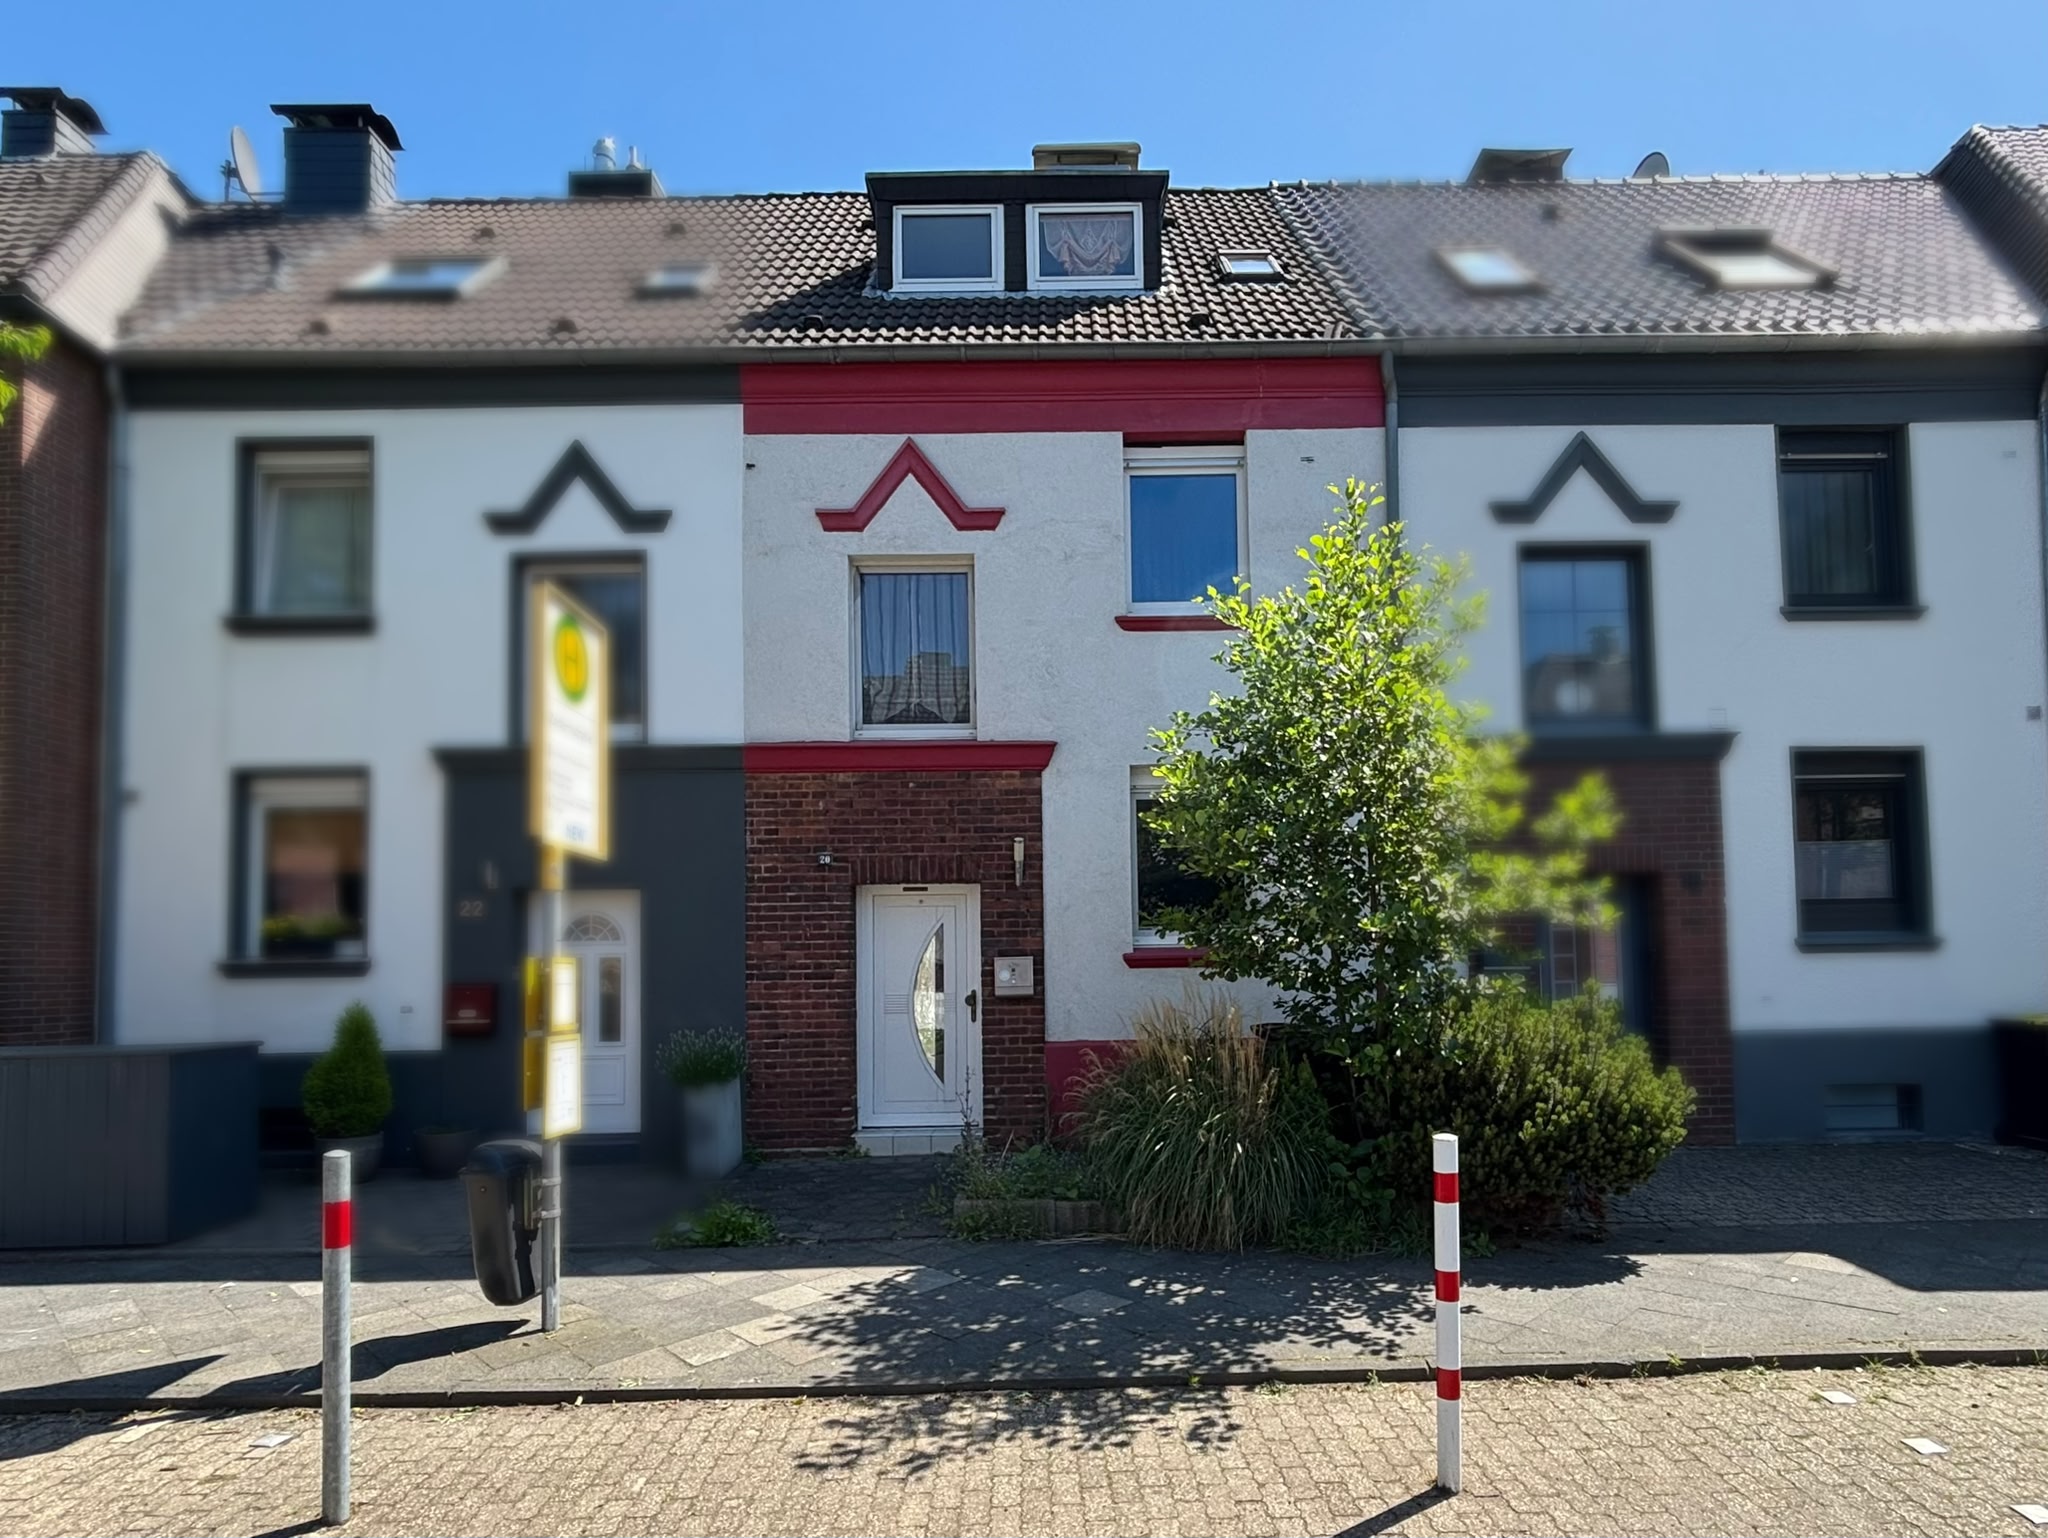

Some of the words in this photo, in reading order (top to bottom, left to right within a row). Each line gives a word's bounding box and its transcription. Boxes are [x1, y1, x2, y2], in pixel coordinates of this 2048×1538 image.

[563, 630, 579, 686] H
[819, 855, 831, 864] 20
[459, 900, 483, 917] 22
